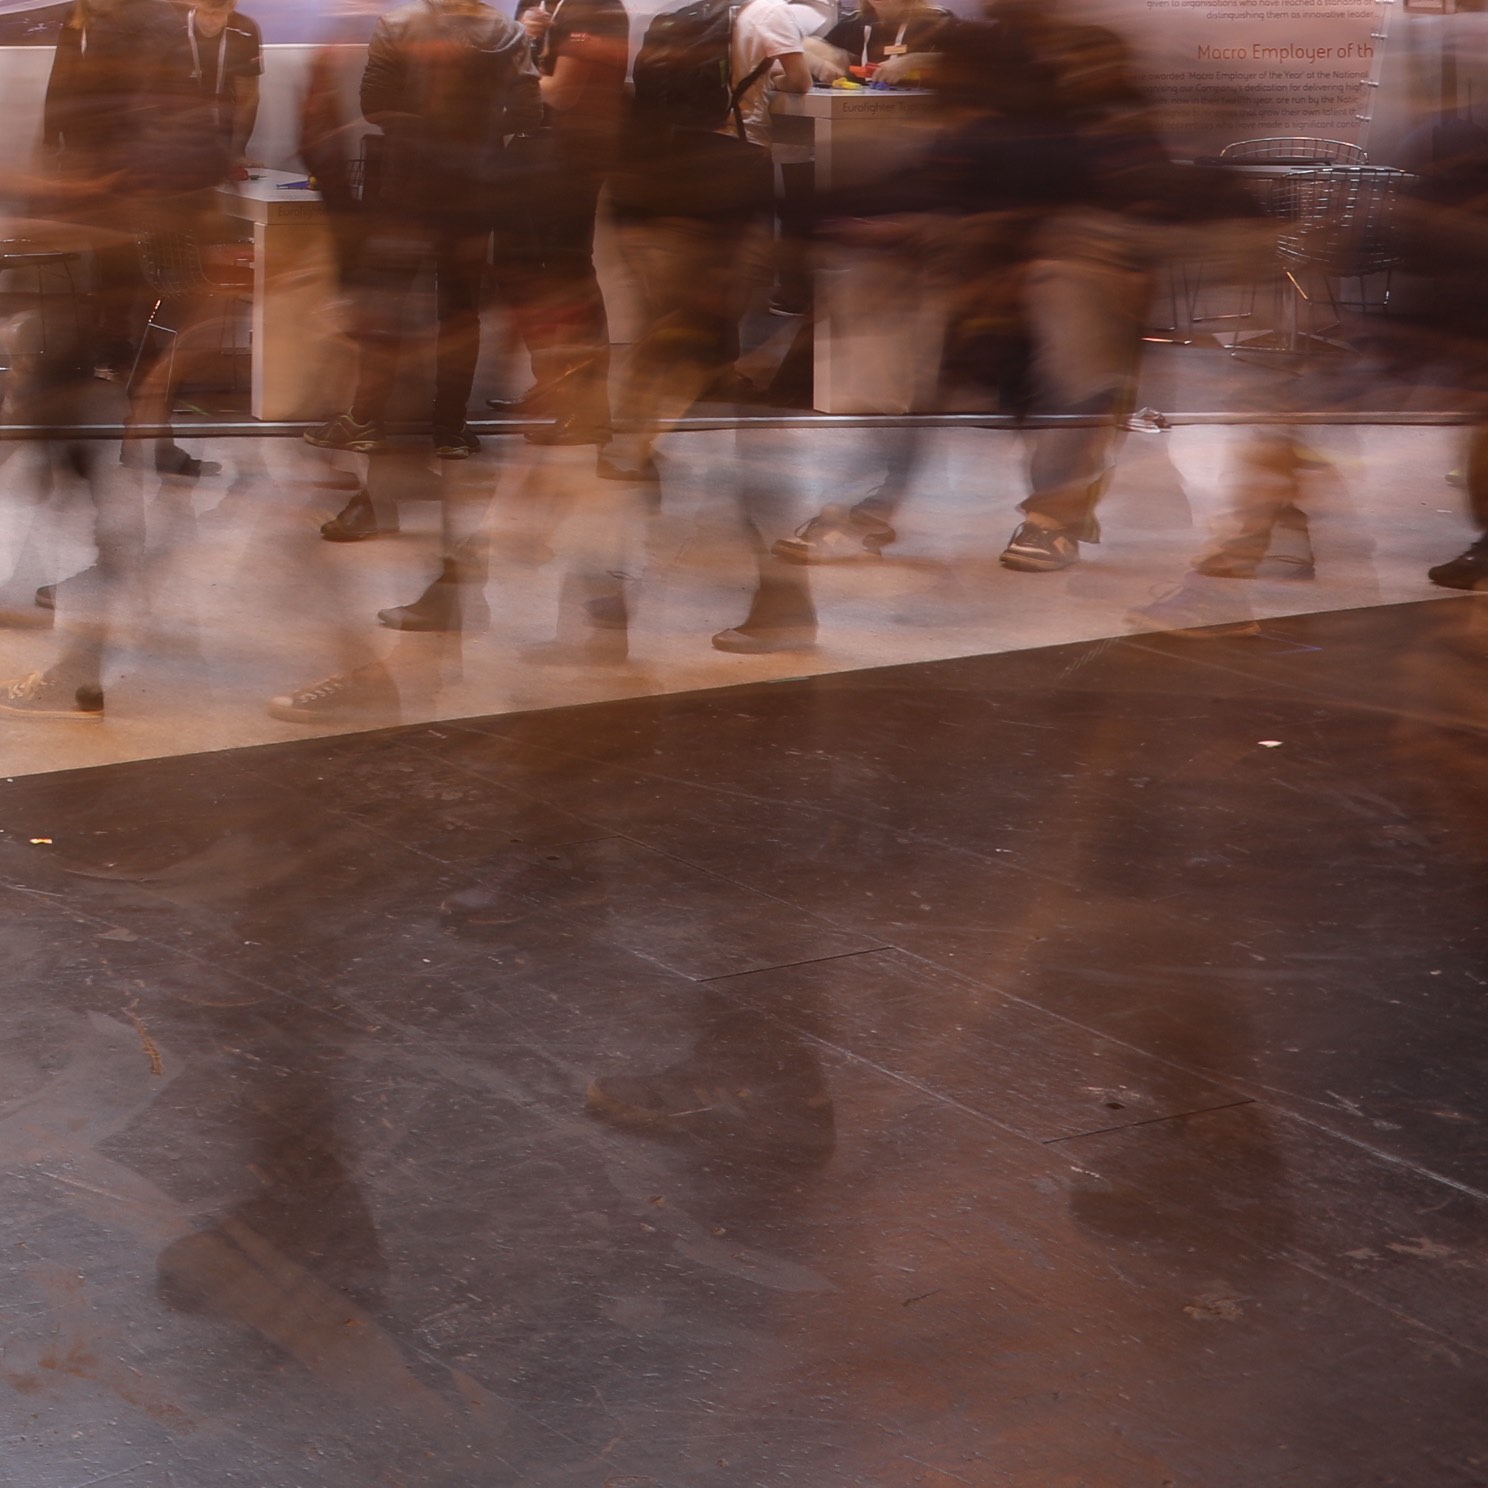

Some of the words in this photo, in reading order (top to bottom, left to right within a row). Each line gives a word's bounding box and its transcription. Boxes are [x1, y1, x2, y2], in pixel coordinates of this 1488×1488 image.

[1147, 0, 1169, 10] given
[1171, 0, 1180, 7] to
[1181, 0, 1237, 9] organisations
[1239, 0, 1257, 7] who
[1259, 0, 1279, 7] have
[1281, 0, 1315, 7] reached
[1206, 11, 1264, 22] distinguishing
[1266, 11, 1289, 19] them
[1303, 11, 1345, 19] innovative
[1197, 45, 1247, 60] Macro
[1253, 44, 1332, 64] Employer
[1337, 43, 1353, 59] of
[1216, 72, 1257, 82] Employer
[1258, 72, 1267, 80] of
[1269, 72, 1283, 80] the
[1306, 72, 1315, 80] at
[1317, 72, 1331, 80] the
[1245, 84, 1288, 92] dedication
[1290, 84, 1300, 92] for
[1303, 84, 1344, 94] delivering
[843, 102, 896, 114] Eurofighter
